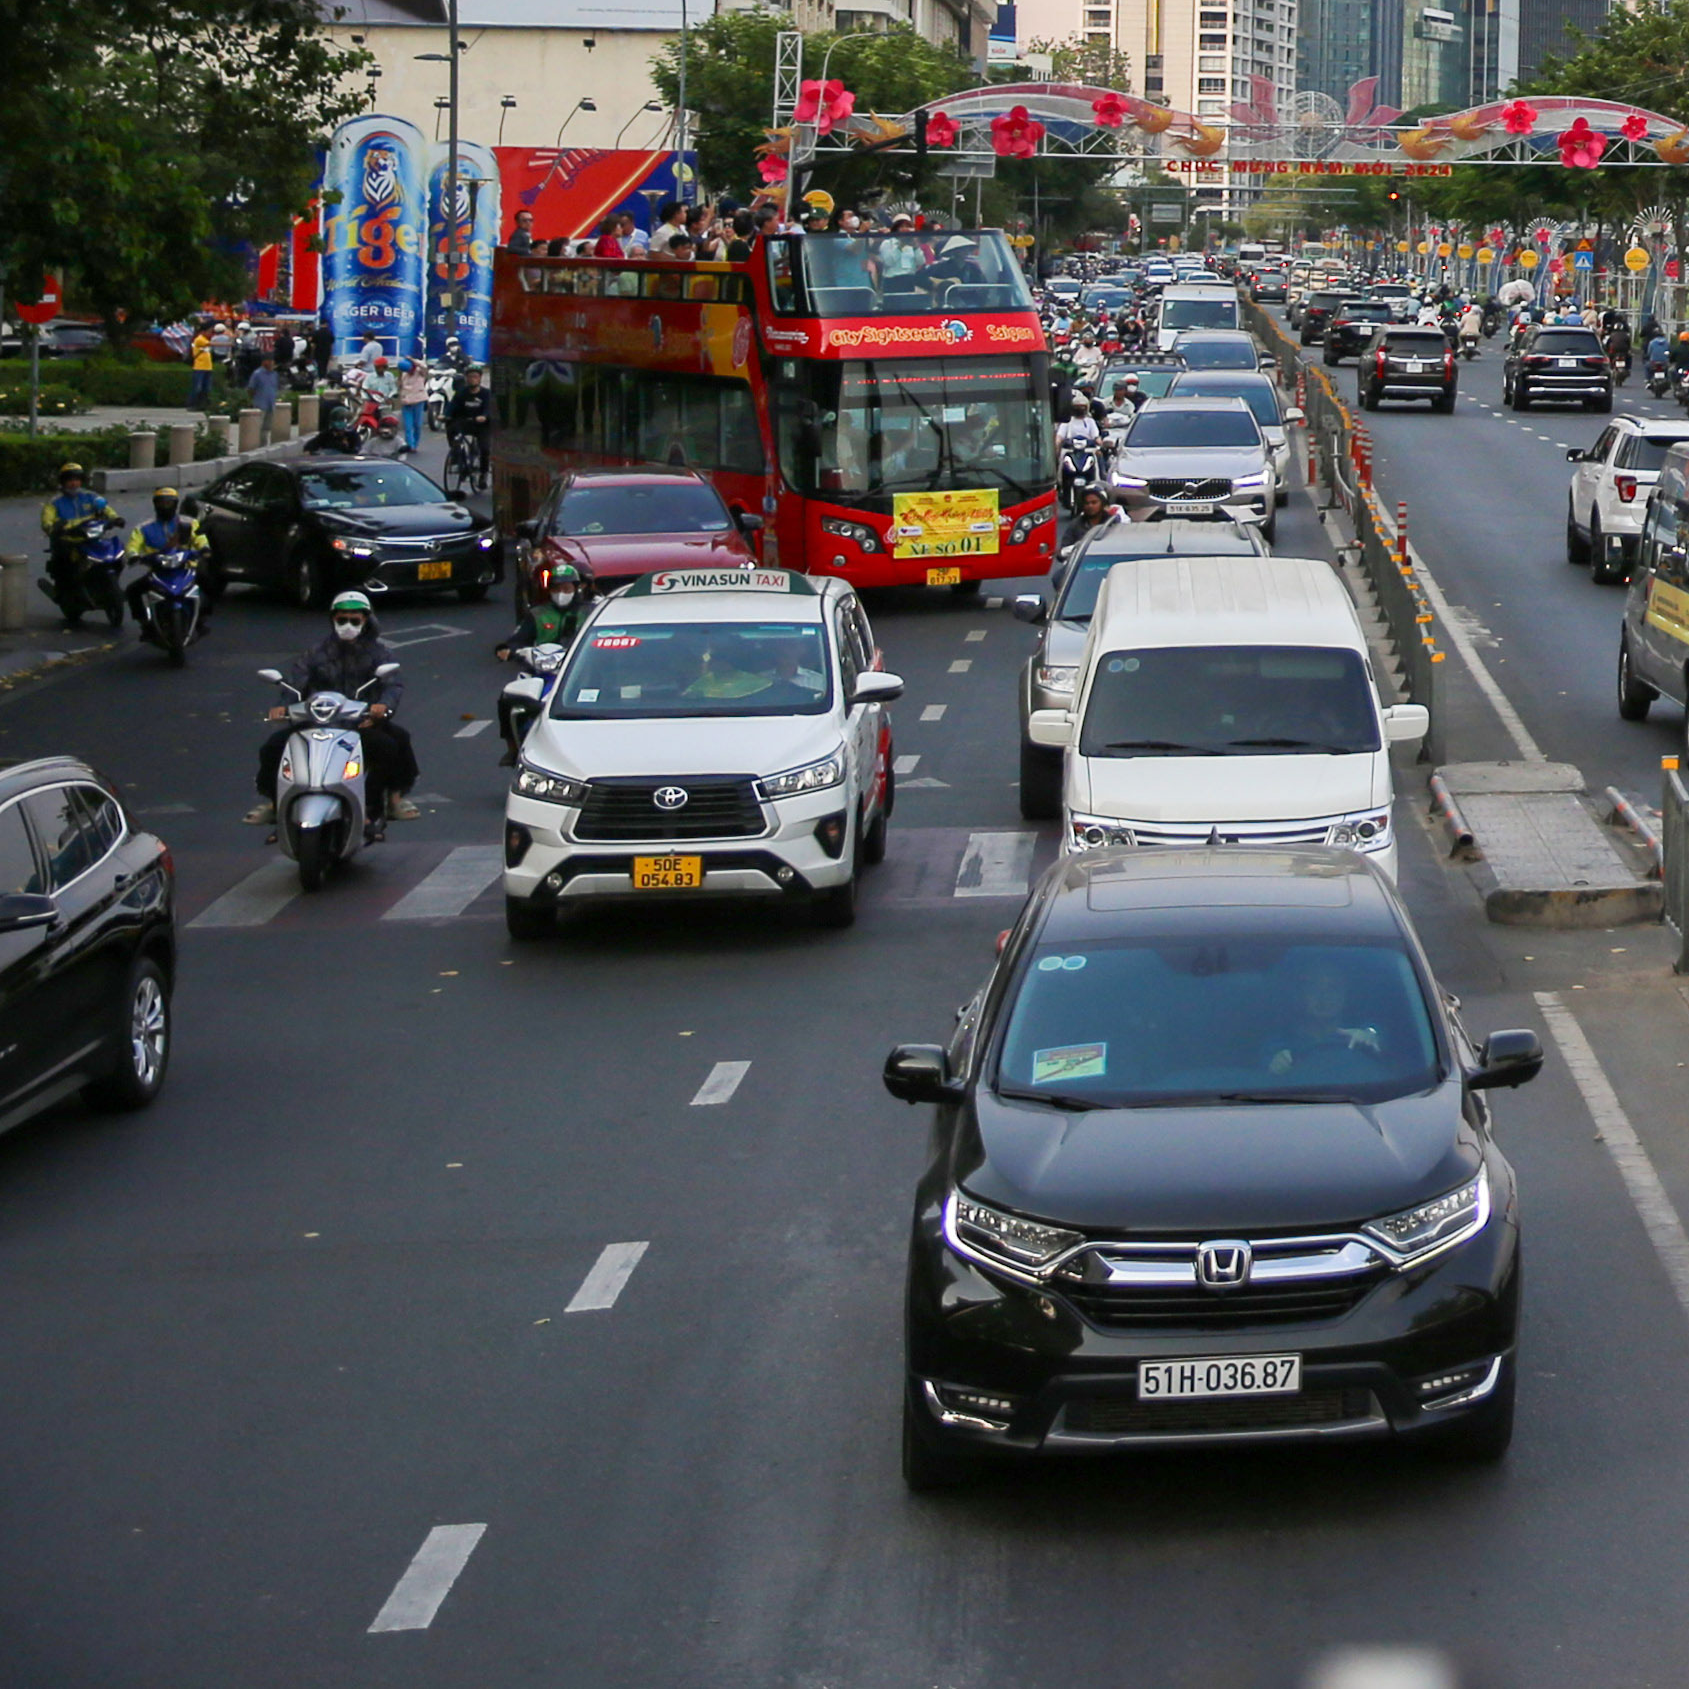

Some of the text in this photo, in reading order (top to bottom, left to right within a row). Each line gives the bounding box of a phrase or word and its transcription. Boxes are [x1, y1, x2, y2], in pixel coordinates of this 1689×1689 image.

[383, 305, 415, 320] BEER
[986, 323, 1035, 343] Saigon
[960, 536, 983, 553] 01
[680, 573, 785, 587] VINASUN TAXI
[653, 857, 683, 872] 50E
[641, 872, 694, 888] 054.83
[1142, 1358, 1297, 1395] 51H-036.87
